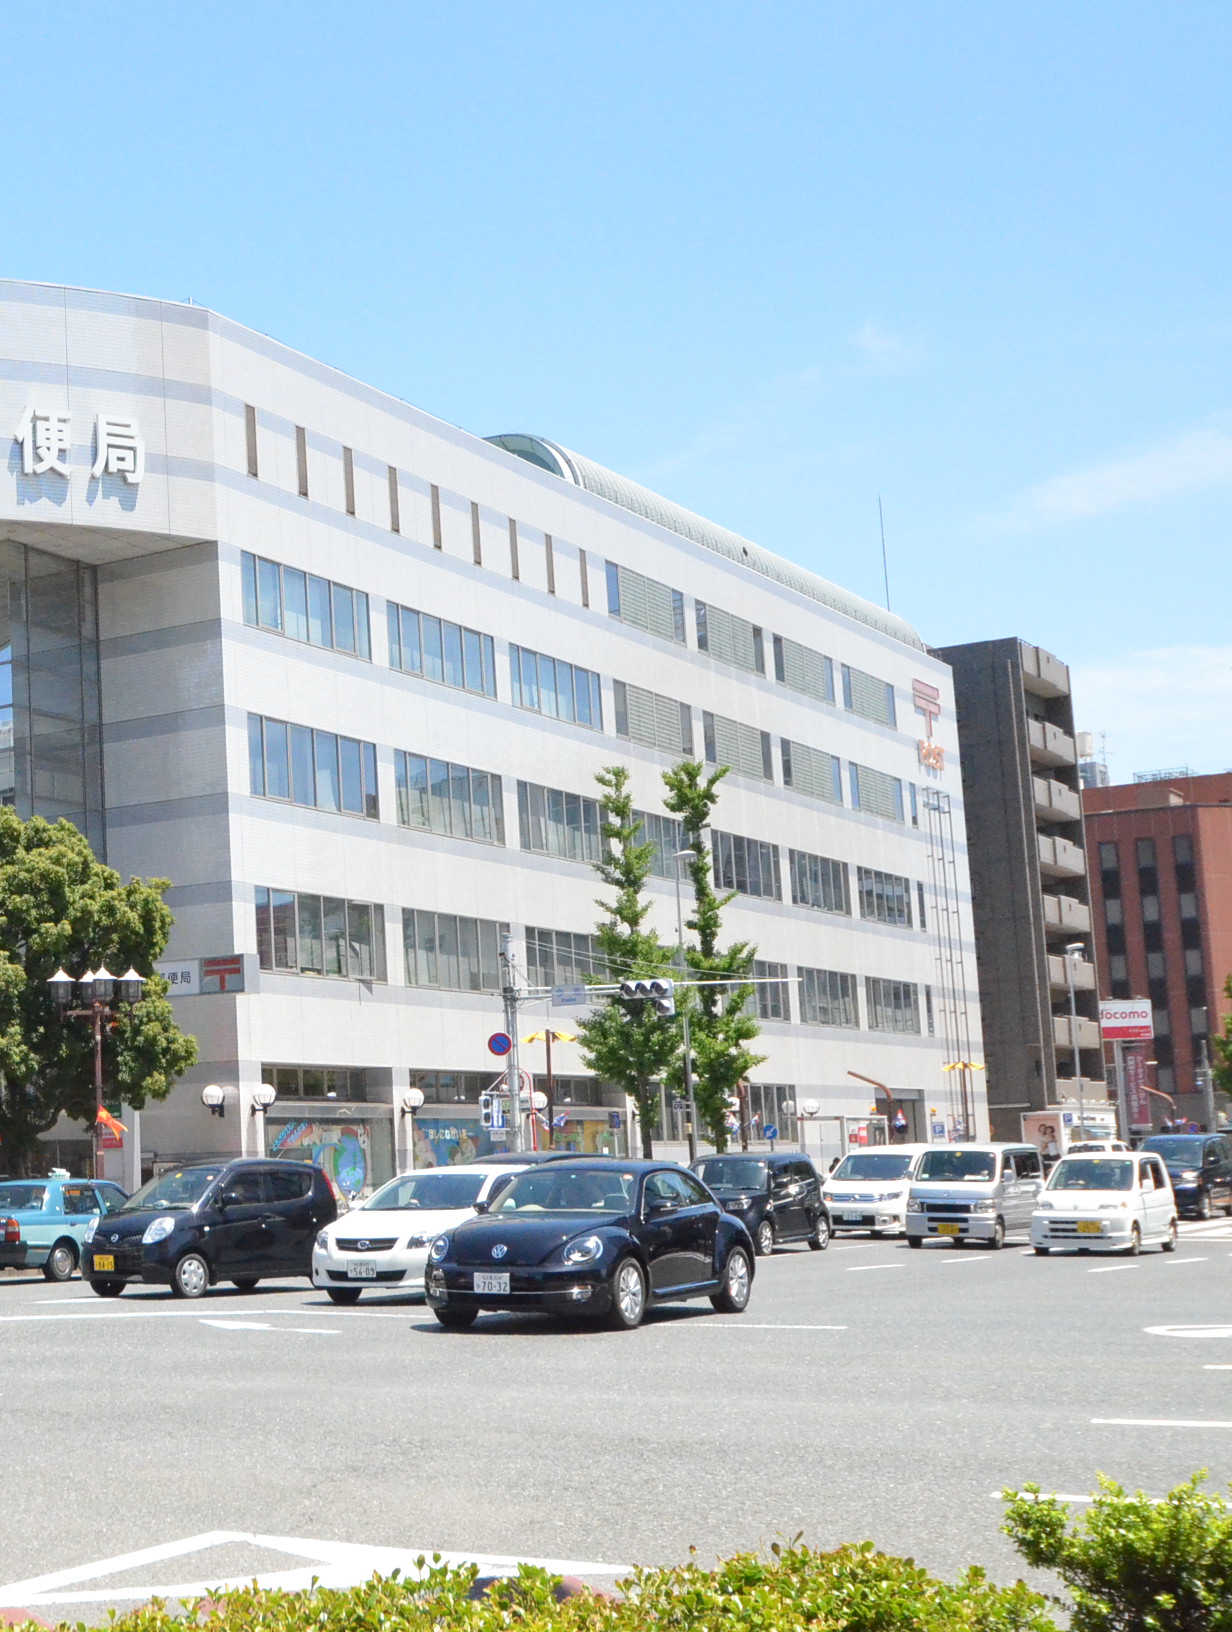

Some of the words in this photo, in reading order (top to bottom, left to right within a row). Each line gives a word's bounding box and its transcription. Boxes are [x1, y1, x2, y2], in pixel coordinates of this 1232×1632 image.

[917, 738, 945, 771] POST
[159, 970, 192, 985] 便局
[353, 1267, 375, 1277] 56-09
[481, 1280, 508, 1293] 70-32
